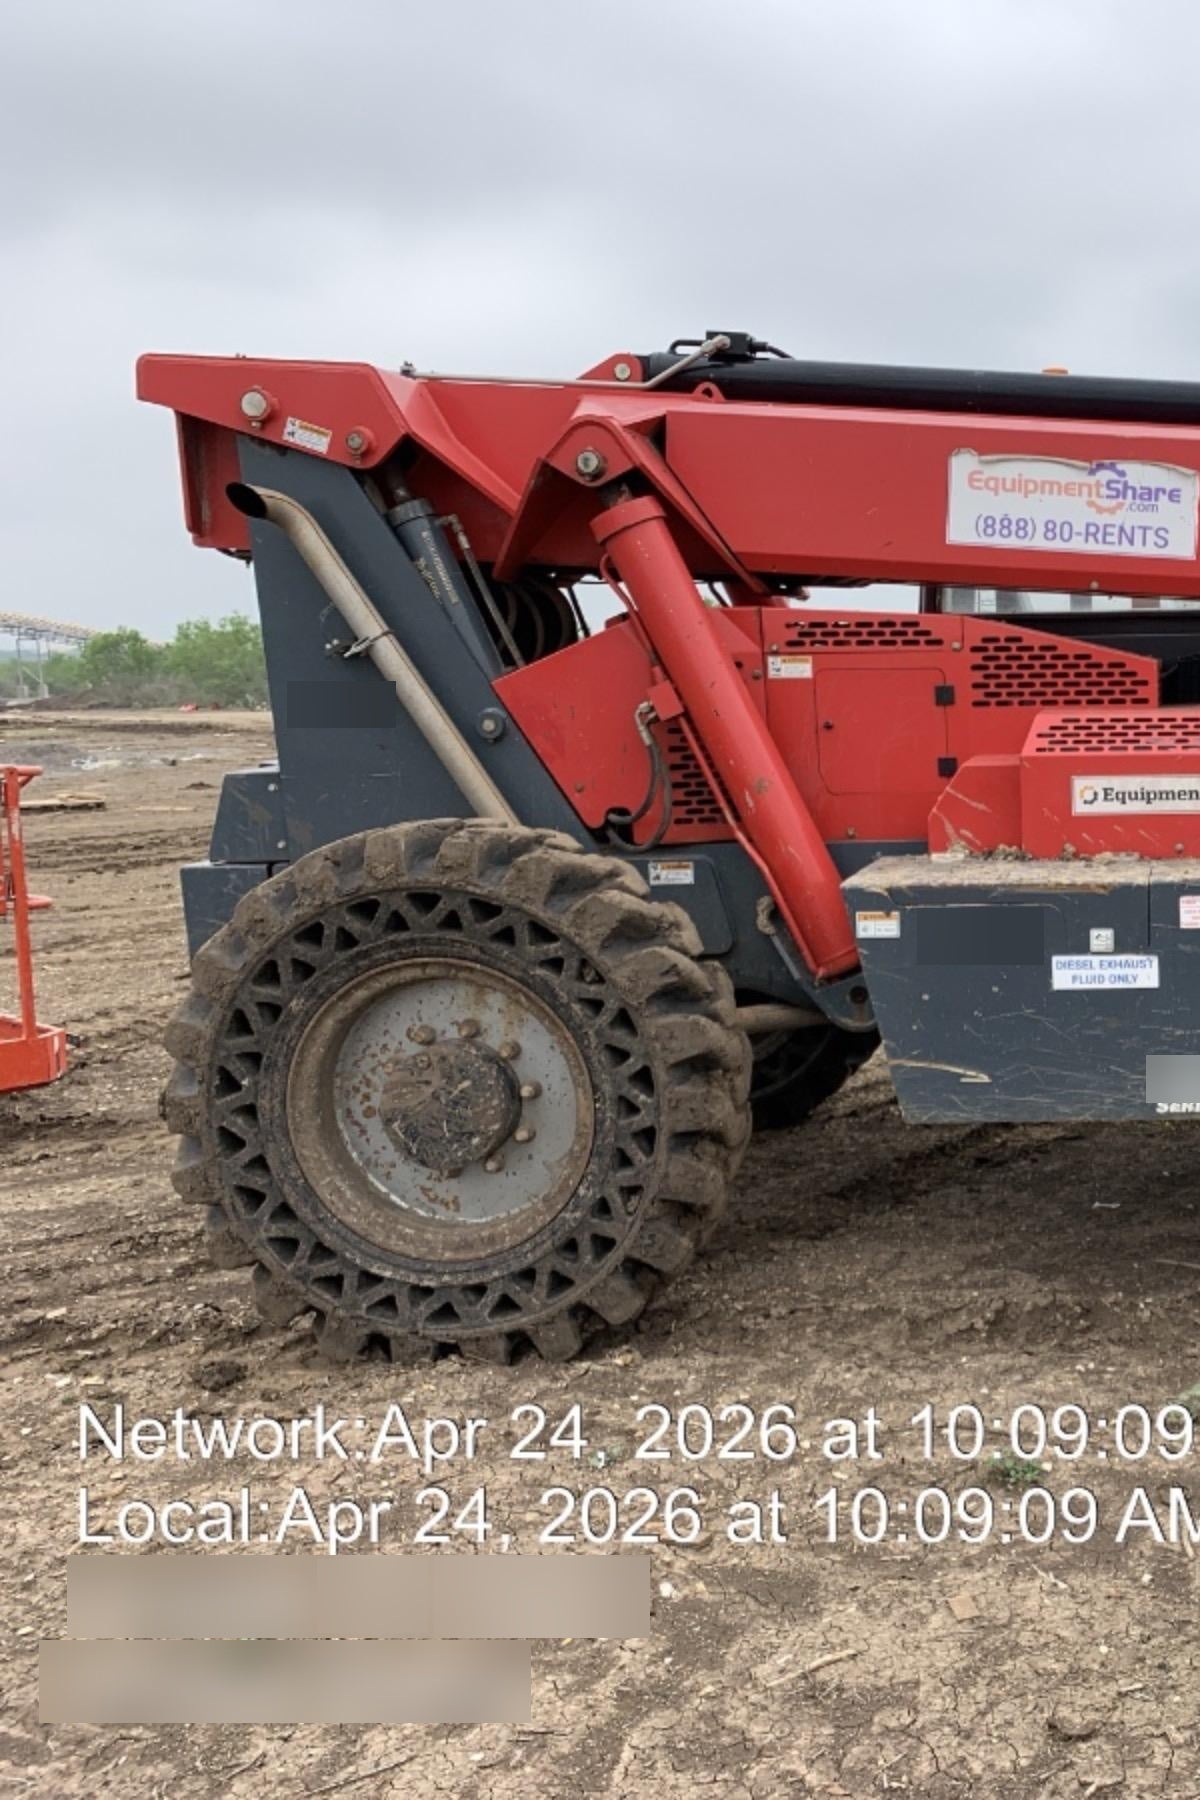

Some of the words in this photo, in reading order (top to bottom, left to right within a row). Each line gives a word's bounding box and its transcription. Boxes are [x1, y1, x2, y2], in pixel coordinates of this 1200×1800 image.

[967, 470, 1182, 503] EquipmentShare
[975, 514, 1037, 542] (888)
[1043, 520, 1170, 549] 80-RENTS
[1055, 959, 1095, 970] DIESEL
[1098, 959, 1154, 969] EXHAUST
[1071, 974, 1106, 985] FLUID
[1107, 974, 1139, 984] ONLY
